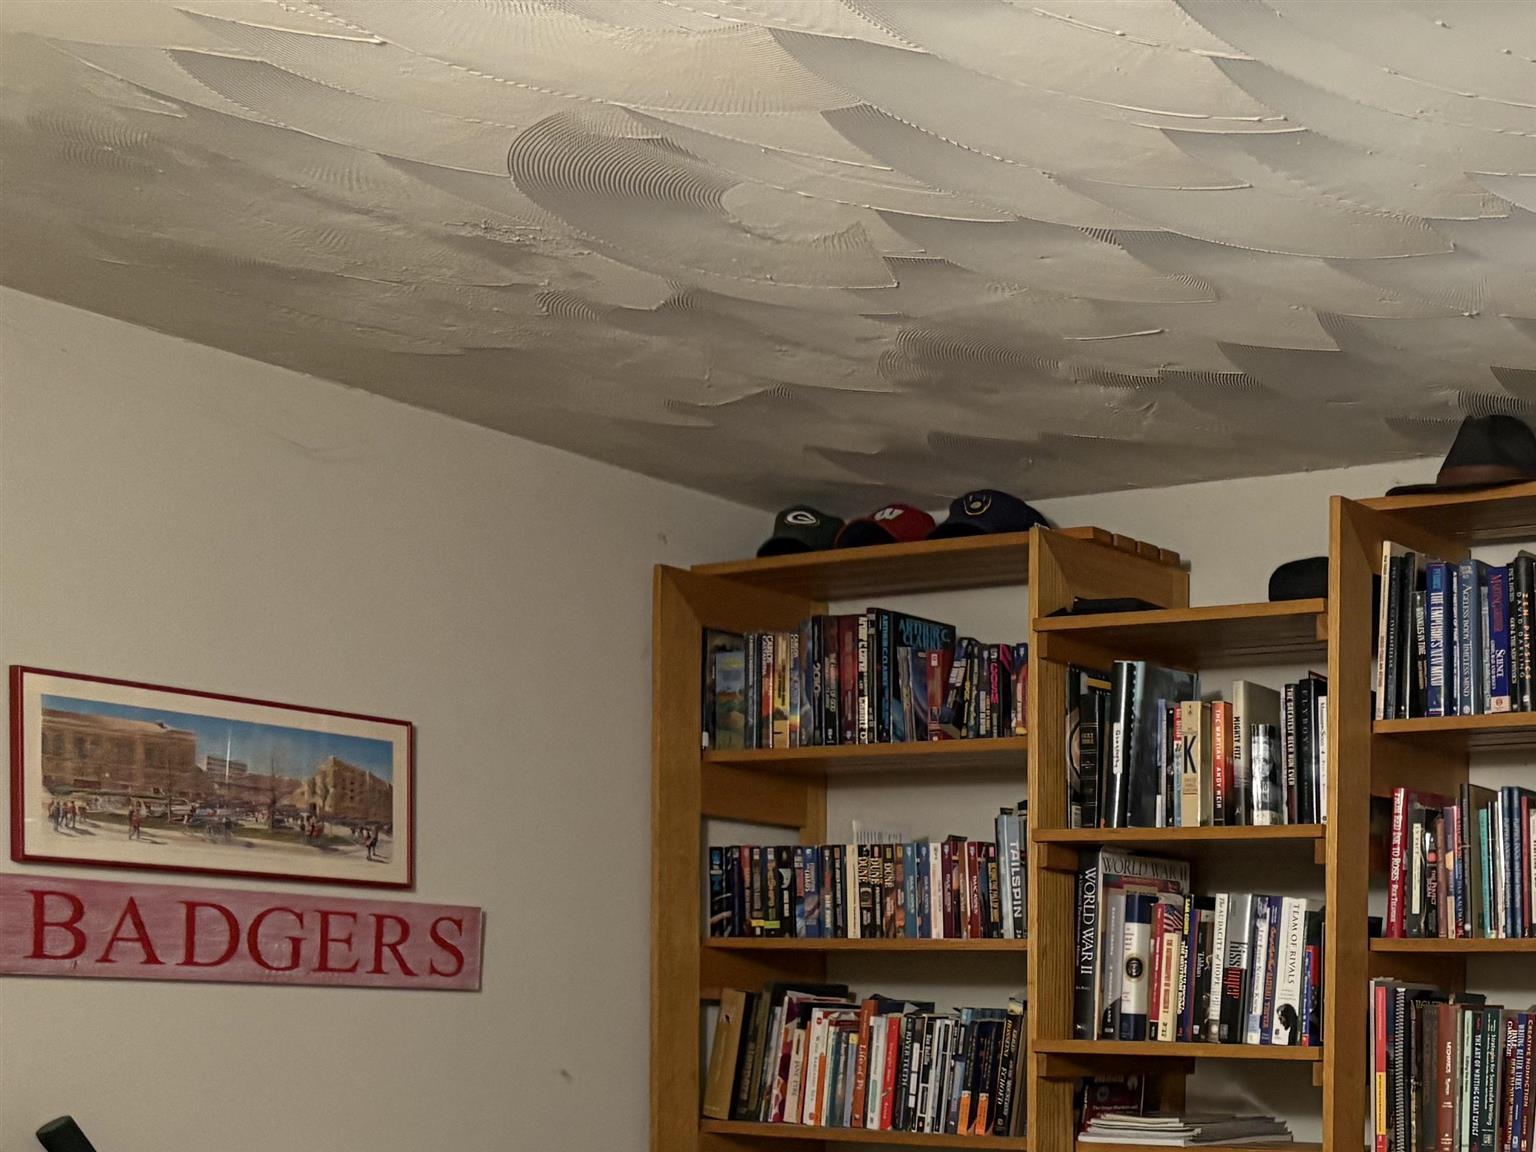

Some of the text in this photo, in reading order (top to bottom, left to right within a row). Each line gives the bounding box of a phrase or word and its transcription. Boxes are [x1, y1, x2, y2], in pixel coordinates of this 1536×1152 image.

[1430, 592, 1444, 606] THE
[1463, 584, 1473, 619] AGELESS
[1463, 619, 1472, 640] BODY
[1463, 643, 1473, 676] TIMELESS
[1495, 649, 1506, 678] SCIENCE
[1518, 632, 1526, 679] DARLING
[1522, 624, 1532, 680] PHYSICS
[813, 662, 821, 693] 2010
[1430, 666, 1444, 686] MIND
[1463, 676, 1472, 697] MIND
[1183, 735, 1198, 774] K
[1391, 846, 1402, 857] TO
[1392, 831, 1402, 845] INK
[859, 856, 869, 883] DUNE
[870, 858, 882, 885] DUNE
[884, 863, 895, 889] DUNE
[1010, 840, 1023, 918] TAILSPIN
[1102, 855, 1148, 877] WORLD
[1149, 862, 1177, 879] WAR
[1390, 857, 1402, 882] ROSES
[24, 887, 466, 978] BADGERS
[1080, 867, 1098, 975] WORLD WAR II
[1216, 953, 1222, 962] of
[1288, 903, 1301, 984] TEAM OF RIVALS
[1214, 963, 1222, 986] HOPE
[1003, 1019, 1013, 1058] HOSSEINI
[1488, 1034, 1497, 1063] Strategies
[1505, 1020, 1514, 1057] CARNEGIE
[1517, 1024, 1525, 1047] WRITING
[856, 1044, 867, 1090] Life of Pi
[1523, 1019, 1534, 1107] CREATIVE NONFICTION
[998, 1067, 1008, 1105] ECHOED
[1471, 1034, 1482, 1137] THE ART OF WRITING GREAT LYRICS
[1488, 1072, 1496, 1102] Successful
[1515, 1071, 1523, 1090] LYRICS
[1486, 1103, 1494, 1126] Writing
